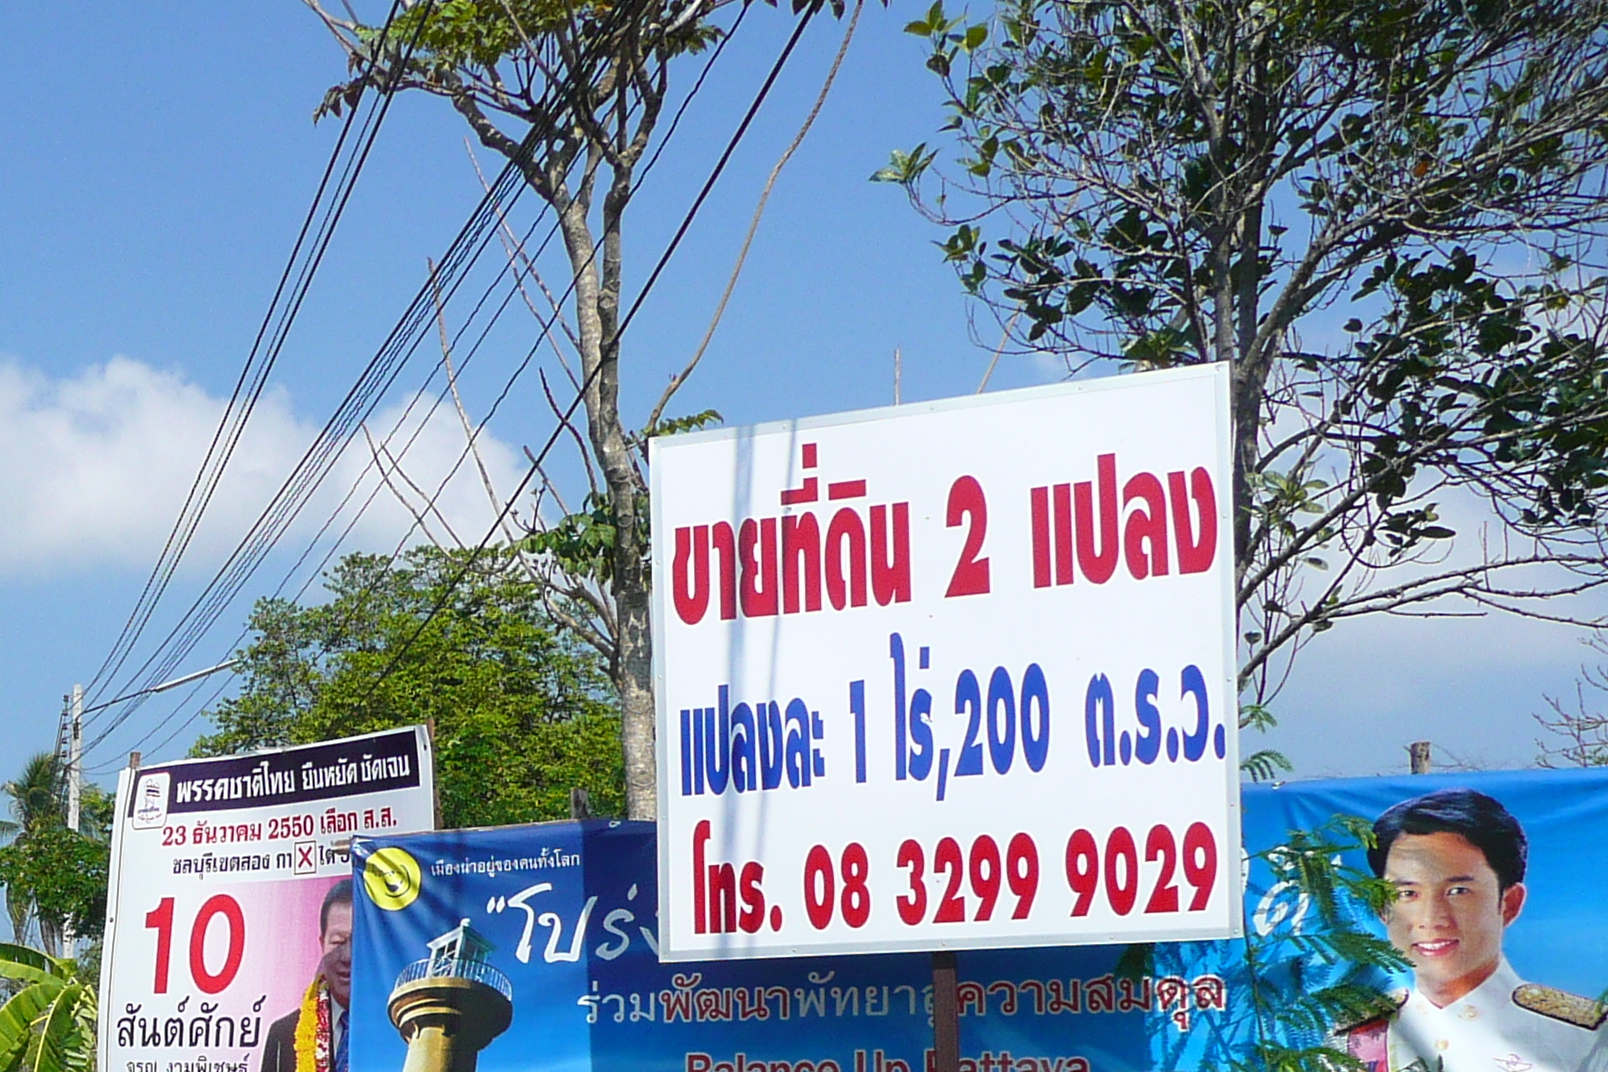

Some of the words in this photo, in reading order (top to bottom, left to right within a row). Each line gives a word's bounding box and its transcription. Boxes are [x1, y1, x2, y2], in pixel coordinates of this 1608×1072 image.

[672, 443, 912, 625] ขายที่ดิน
[944, 475, 991, 598] 2
[1030, 452, 1218, 588] แปลง
[679, 684, 826, 796] แปลงละ
[849, 680, 867, 783] 1
[176, 760, 296, 803] พรรคชาติไทย
[302, 757, 358, 791] ยืนหยัด
[360, 753, 411, 782] ชัดเจน
[162, 825, 187, 847] 23
[192, 820, 262, 845] ธันวาคม
[268, 814, 314, 840] 2550
[320, 807, 358, 835] เลือก
[364, 806, 397, 829] ส.ส.
[173, 852, 270, 880] ชลบุรีเขตสอง
[430, 846, 581, 878] เมืองน่าอยู่ของคนทั้งโลก
[693, 820, 783, 934] โทร.
[804, 842, 870, 931] 08
[895, 832, 1040, 926] 3299
[1065, 821, 1218, 917] 9029
[145, 893, 246, 995] 10
[117, 994, 267, 1048] สันต์ศักย์
